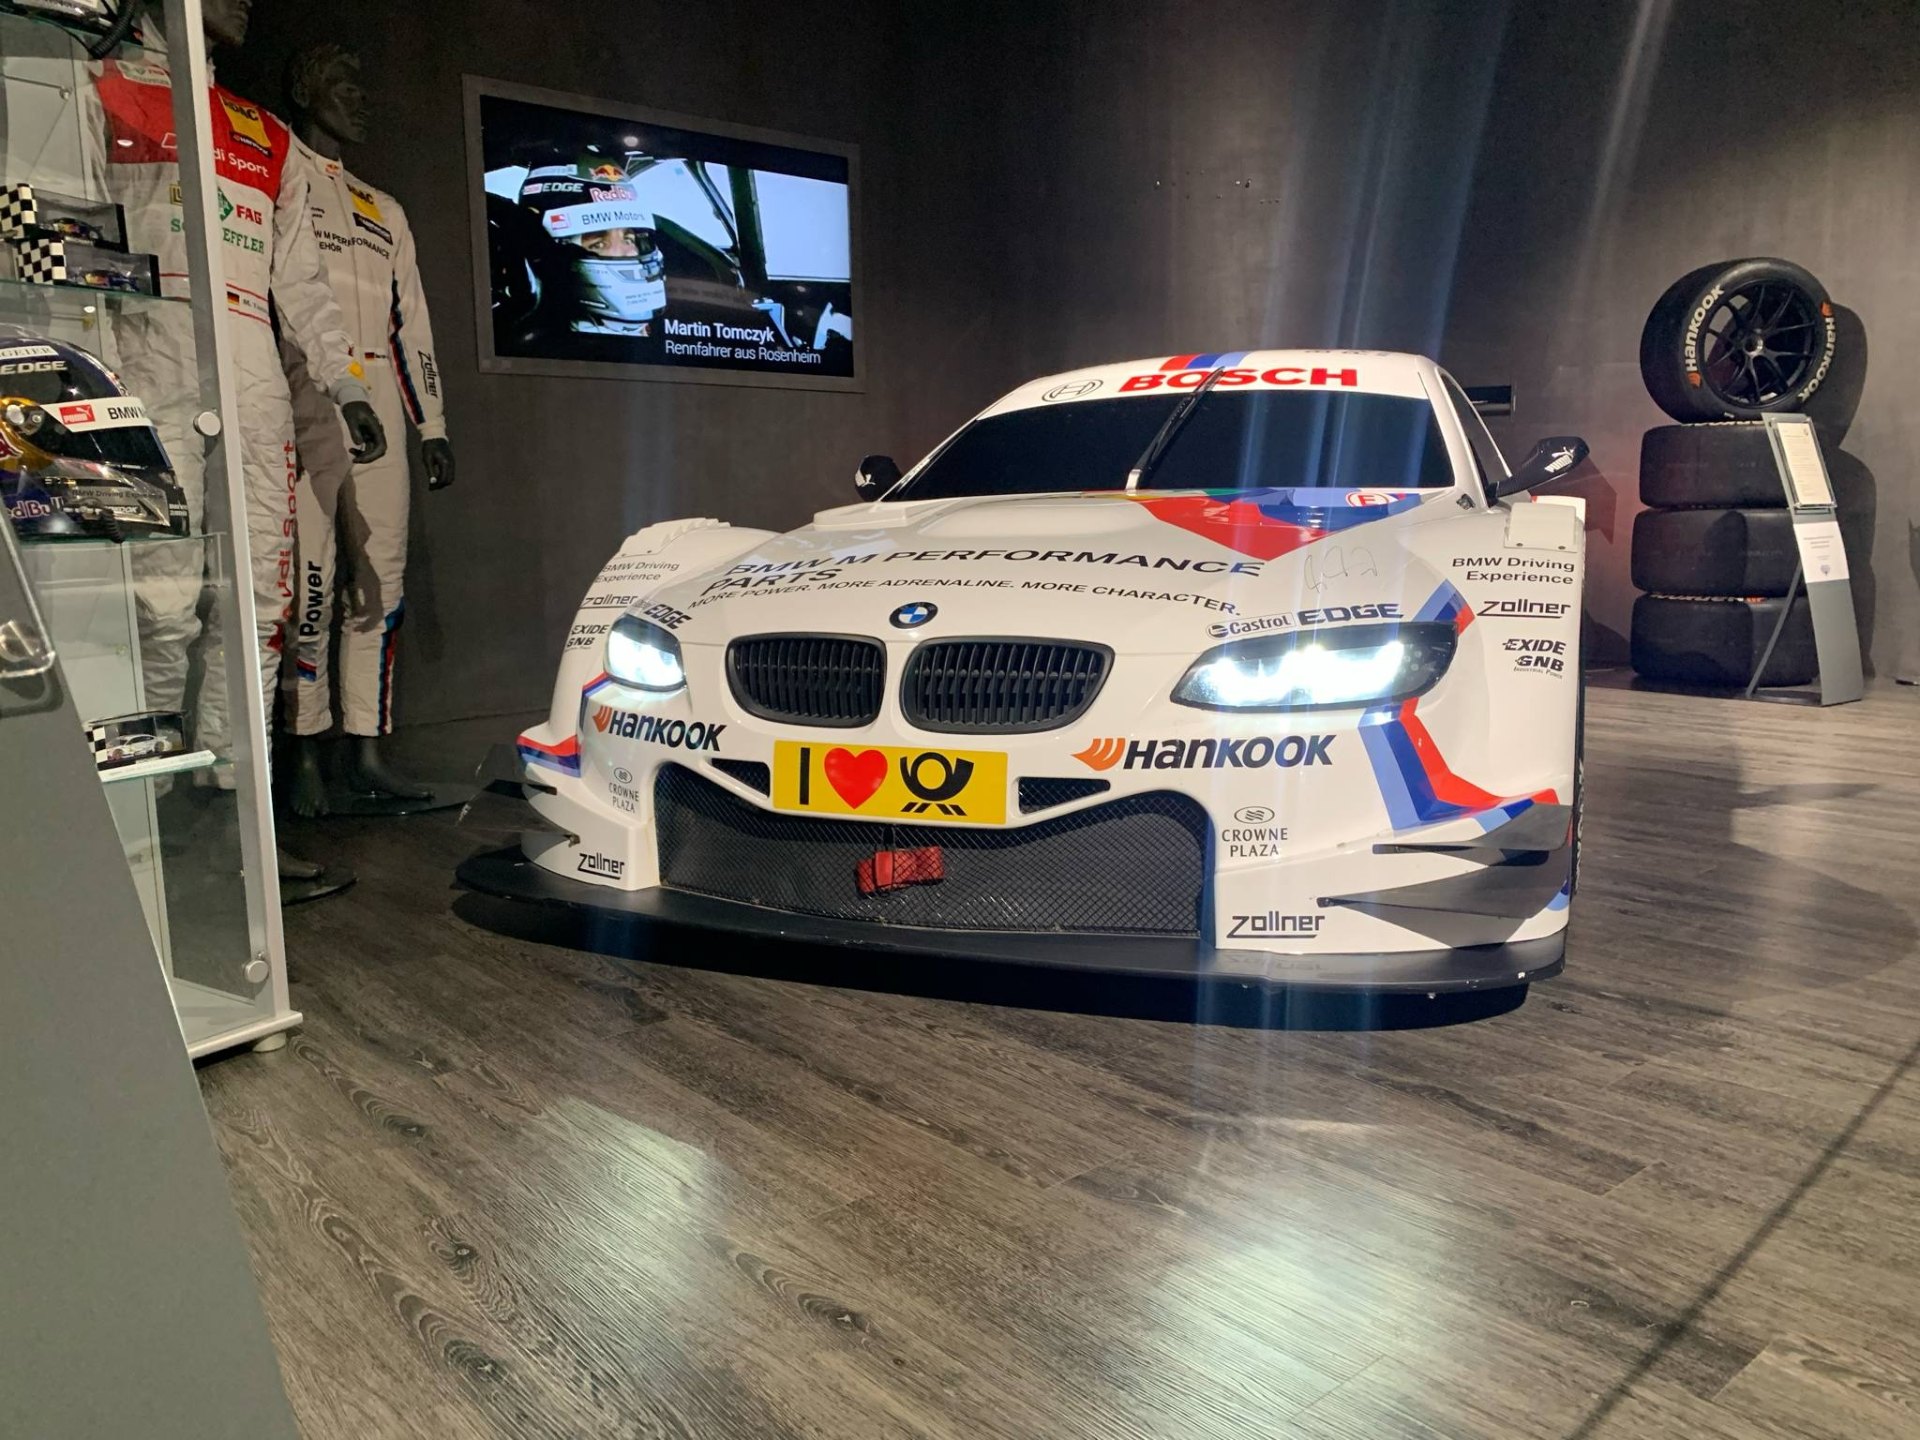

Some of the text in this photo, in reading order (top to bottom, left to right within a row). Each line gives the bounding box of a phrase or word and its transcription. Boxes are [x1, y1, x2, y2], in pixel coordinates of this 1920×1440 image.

[228, 152, 269, 178] Sport
[542, 182, 584, 193] EDGE
[236, 204, 263, 225] FAG
[581, 211, 611, 225] BMW
[664, 318, 776, 345] Martin Tomczyk
[665, 339, 822, 364] Rennfahrer aus Rosenheim
[0, 360, 68, 375] EDGE
[1119, 367, 1358, 392] BOSCH
[107, 406, 139, 420] BMW
[602, 561, 680, 573] BMW Driving
[724, 549, 1265, 577] BMW M PERFORMANCE
[1452, 557, 1575, 573] BMW Driving
[700, 568, 843, 597] PARTS
[1466, 570, 1574, 585] Experience
[300, 561, 323, 637] Power
[687, 591, 737, 610] MORE
[741, 584, 811, 598] POWER.
[814, 578, 876, 591] MORE
[1020, 581, 1088, 593] MORE
[1091, 586, 1241, 616] CHARACTER.
[643, 604, 693, 630] EDGE
[1229, 603, 1404, 635] Castrol EDGE
[571, 624, 610, 635] EXIDE
[1502, 638, 1567, 656] EXIDE
[1515, 655, 1565, 672] GNB
[799, 747, 811, 806] I
[608, 782, 640, 802] CROWNE
[612, 796, 636, 813] PLAZA
[1221, 827, 1288, 843] CROWNE
[1229, 844, 1280, 858] PLAZA
